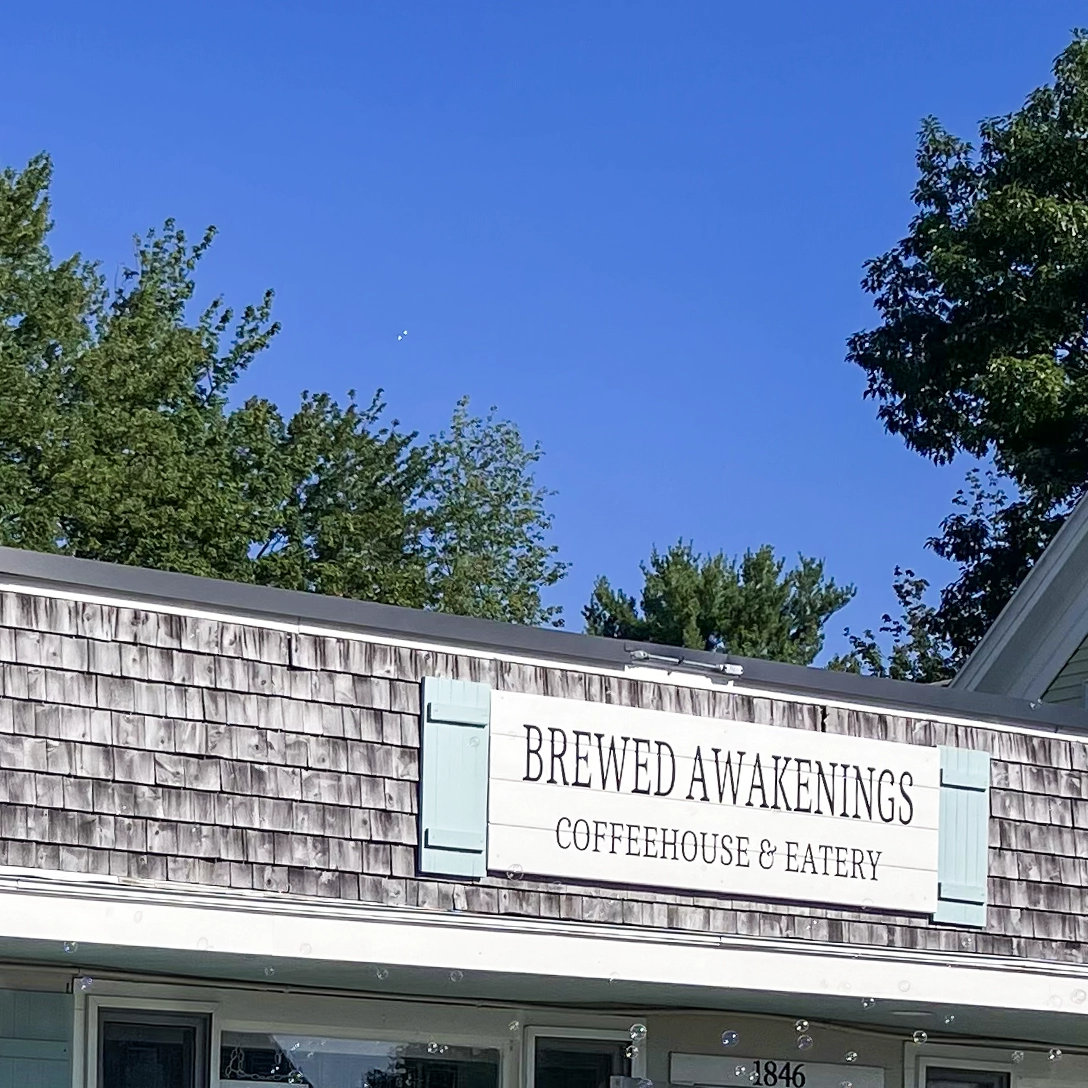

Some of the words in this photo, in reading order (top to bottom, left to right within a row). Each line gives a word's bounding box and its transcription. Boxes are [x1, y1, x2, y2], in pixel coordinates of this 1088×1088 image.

[523, 724, 676, 796] BREWED
[685, 746, 914, 825] AWAKENINGS
[556, 817, 750, 867] COFFEEHOUSE
[759, 839, 777, 869] &
[785, 841, 883, 881] EATERY
[753, 1060, 806, 1088] 1846
